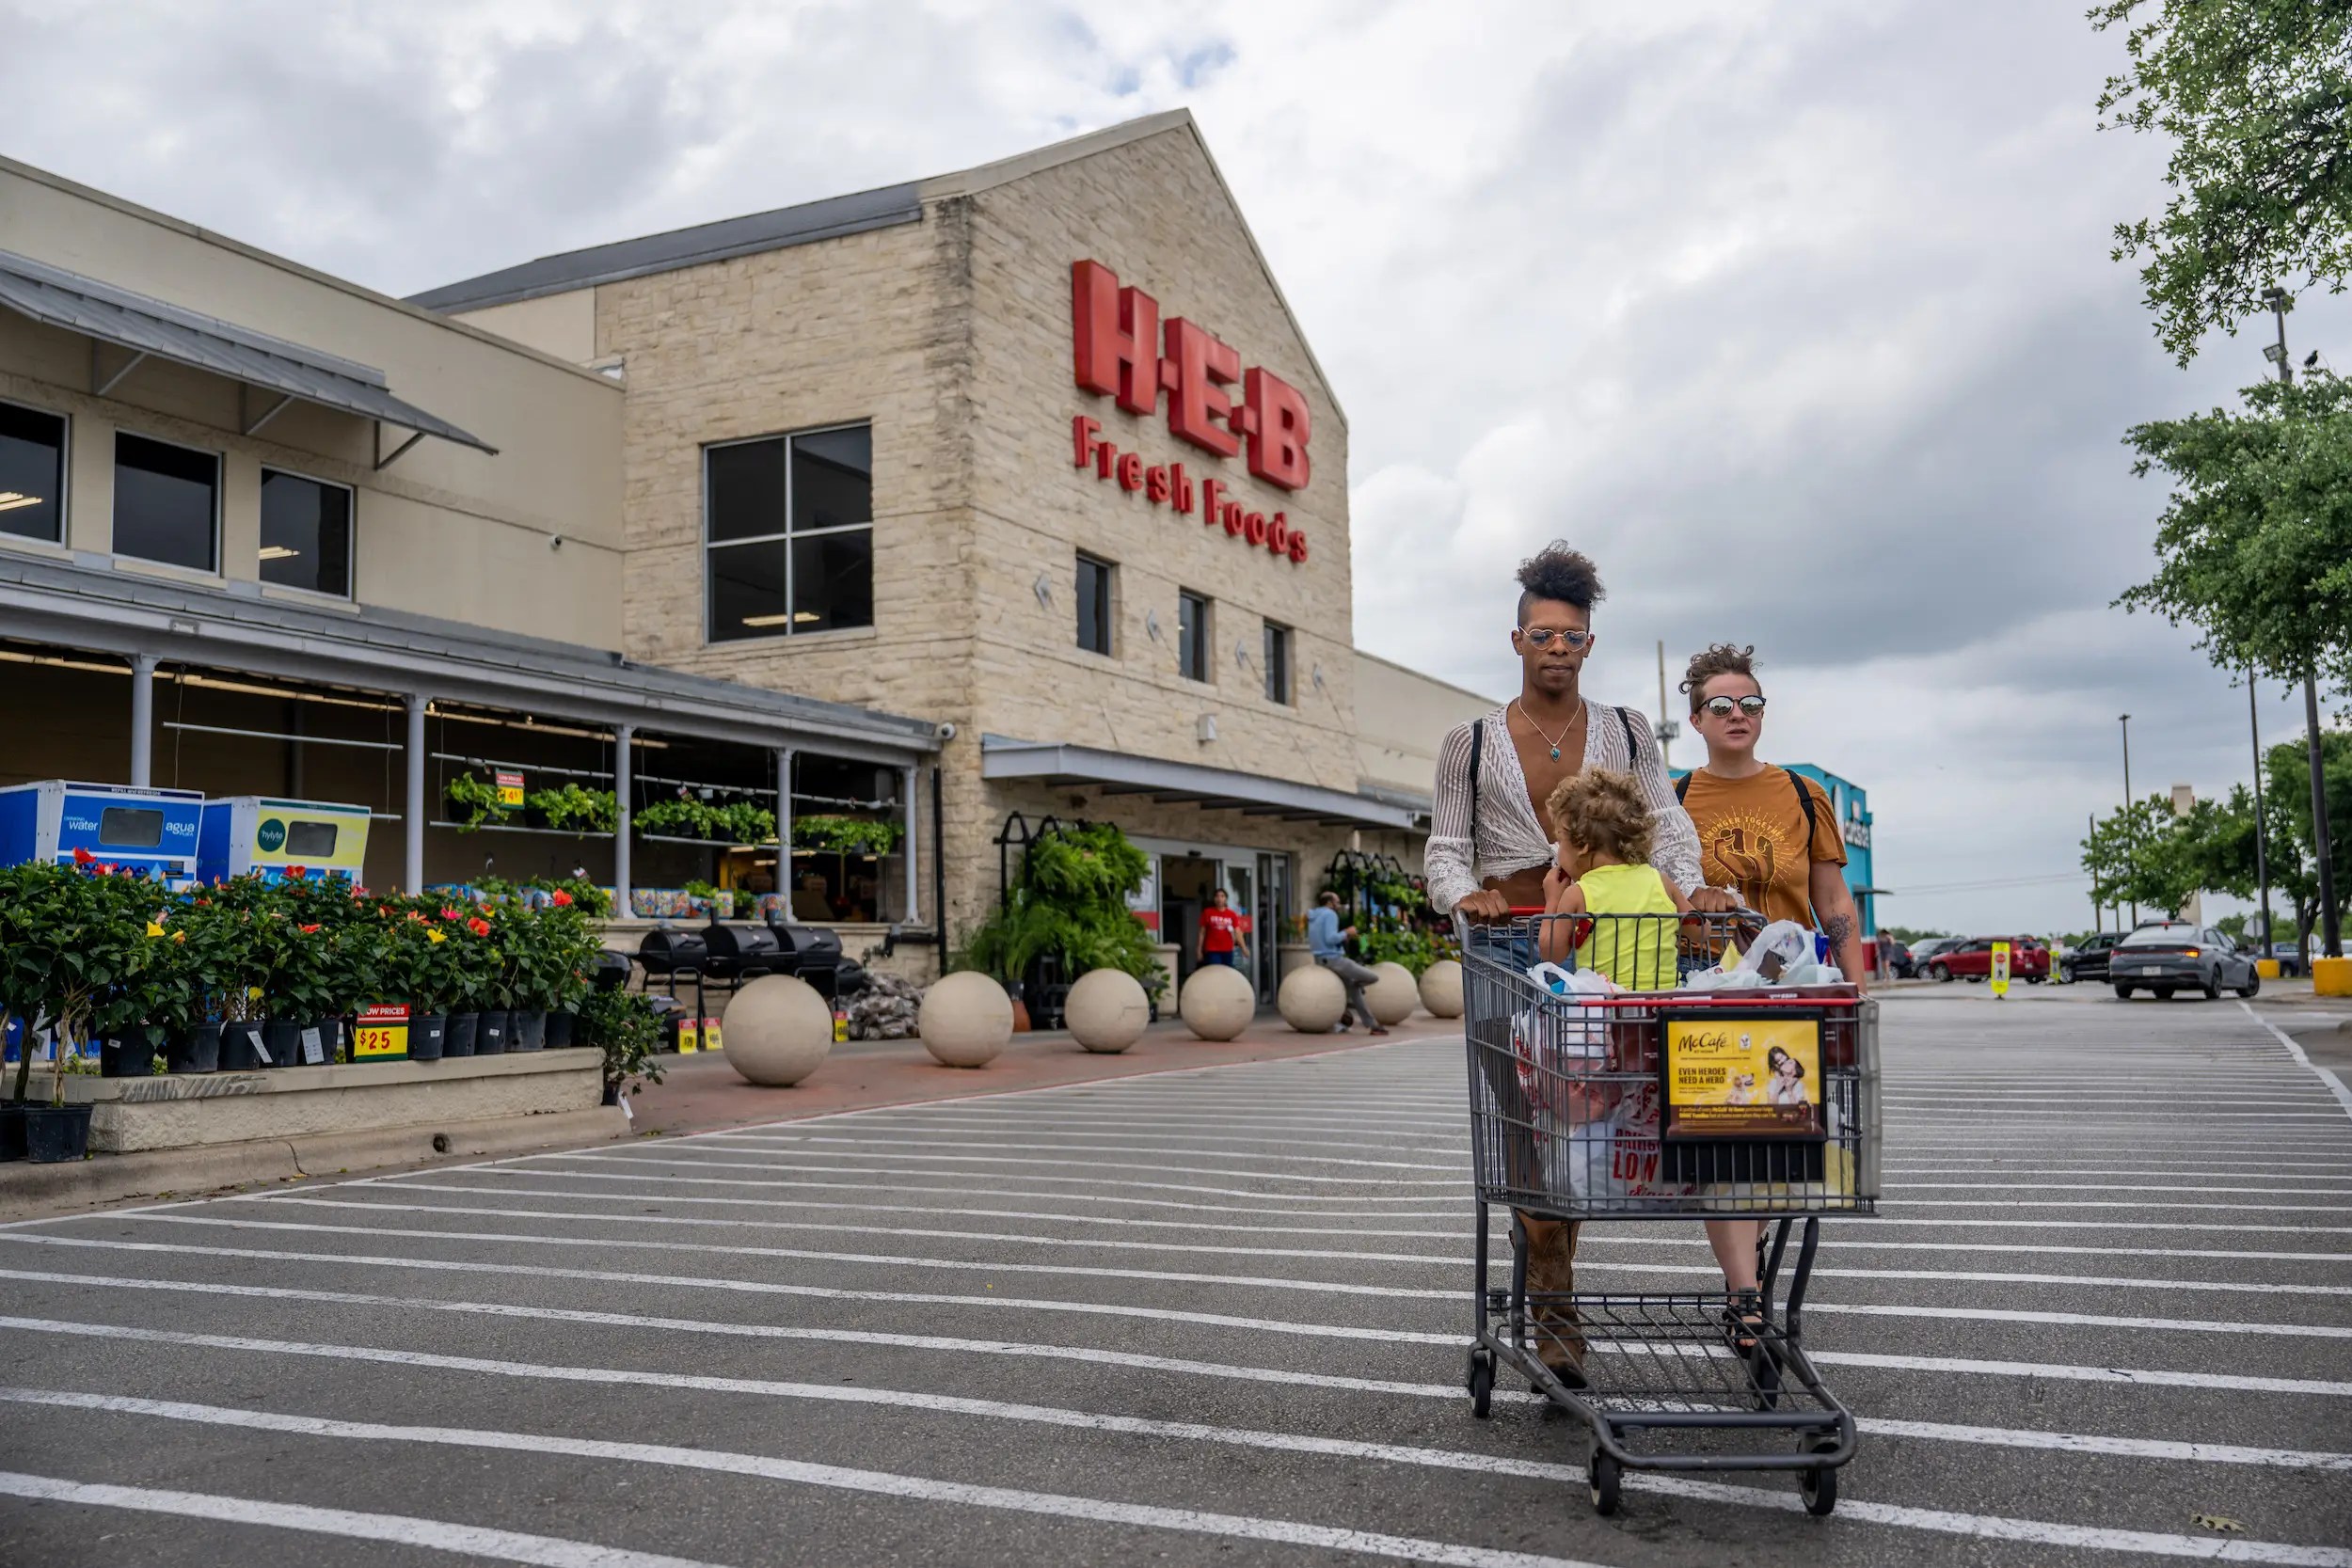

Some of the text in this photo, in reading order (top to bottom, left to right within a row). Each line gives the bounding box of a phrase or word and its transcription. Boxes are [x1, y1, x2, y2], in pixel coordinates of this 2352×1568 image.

[1073, 415, 1308, 563] Fresh Foods
[69, 819, 99, 832] water
[166, 821, 195, 835] agua
[1701, 816, 1786, 844] STRONGER TOGETHER
[262, 829, 283, 842] hylyte
[366, 1006, 405, 1016] OW PRICES
[1677, 1032, 1727, 1053] McCafé
[1678, 1067, 1726, 1076] EVEN HEROES
[1678, 1076, 1724, 1085] NEED A HERO
